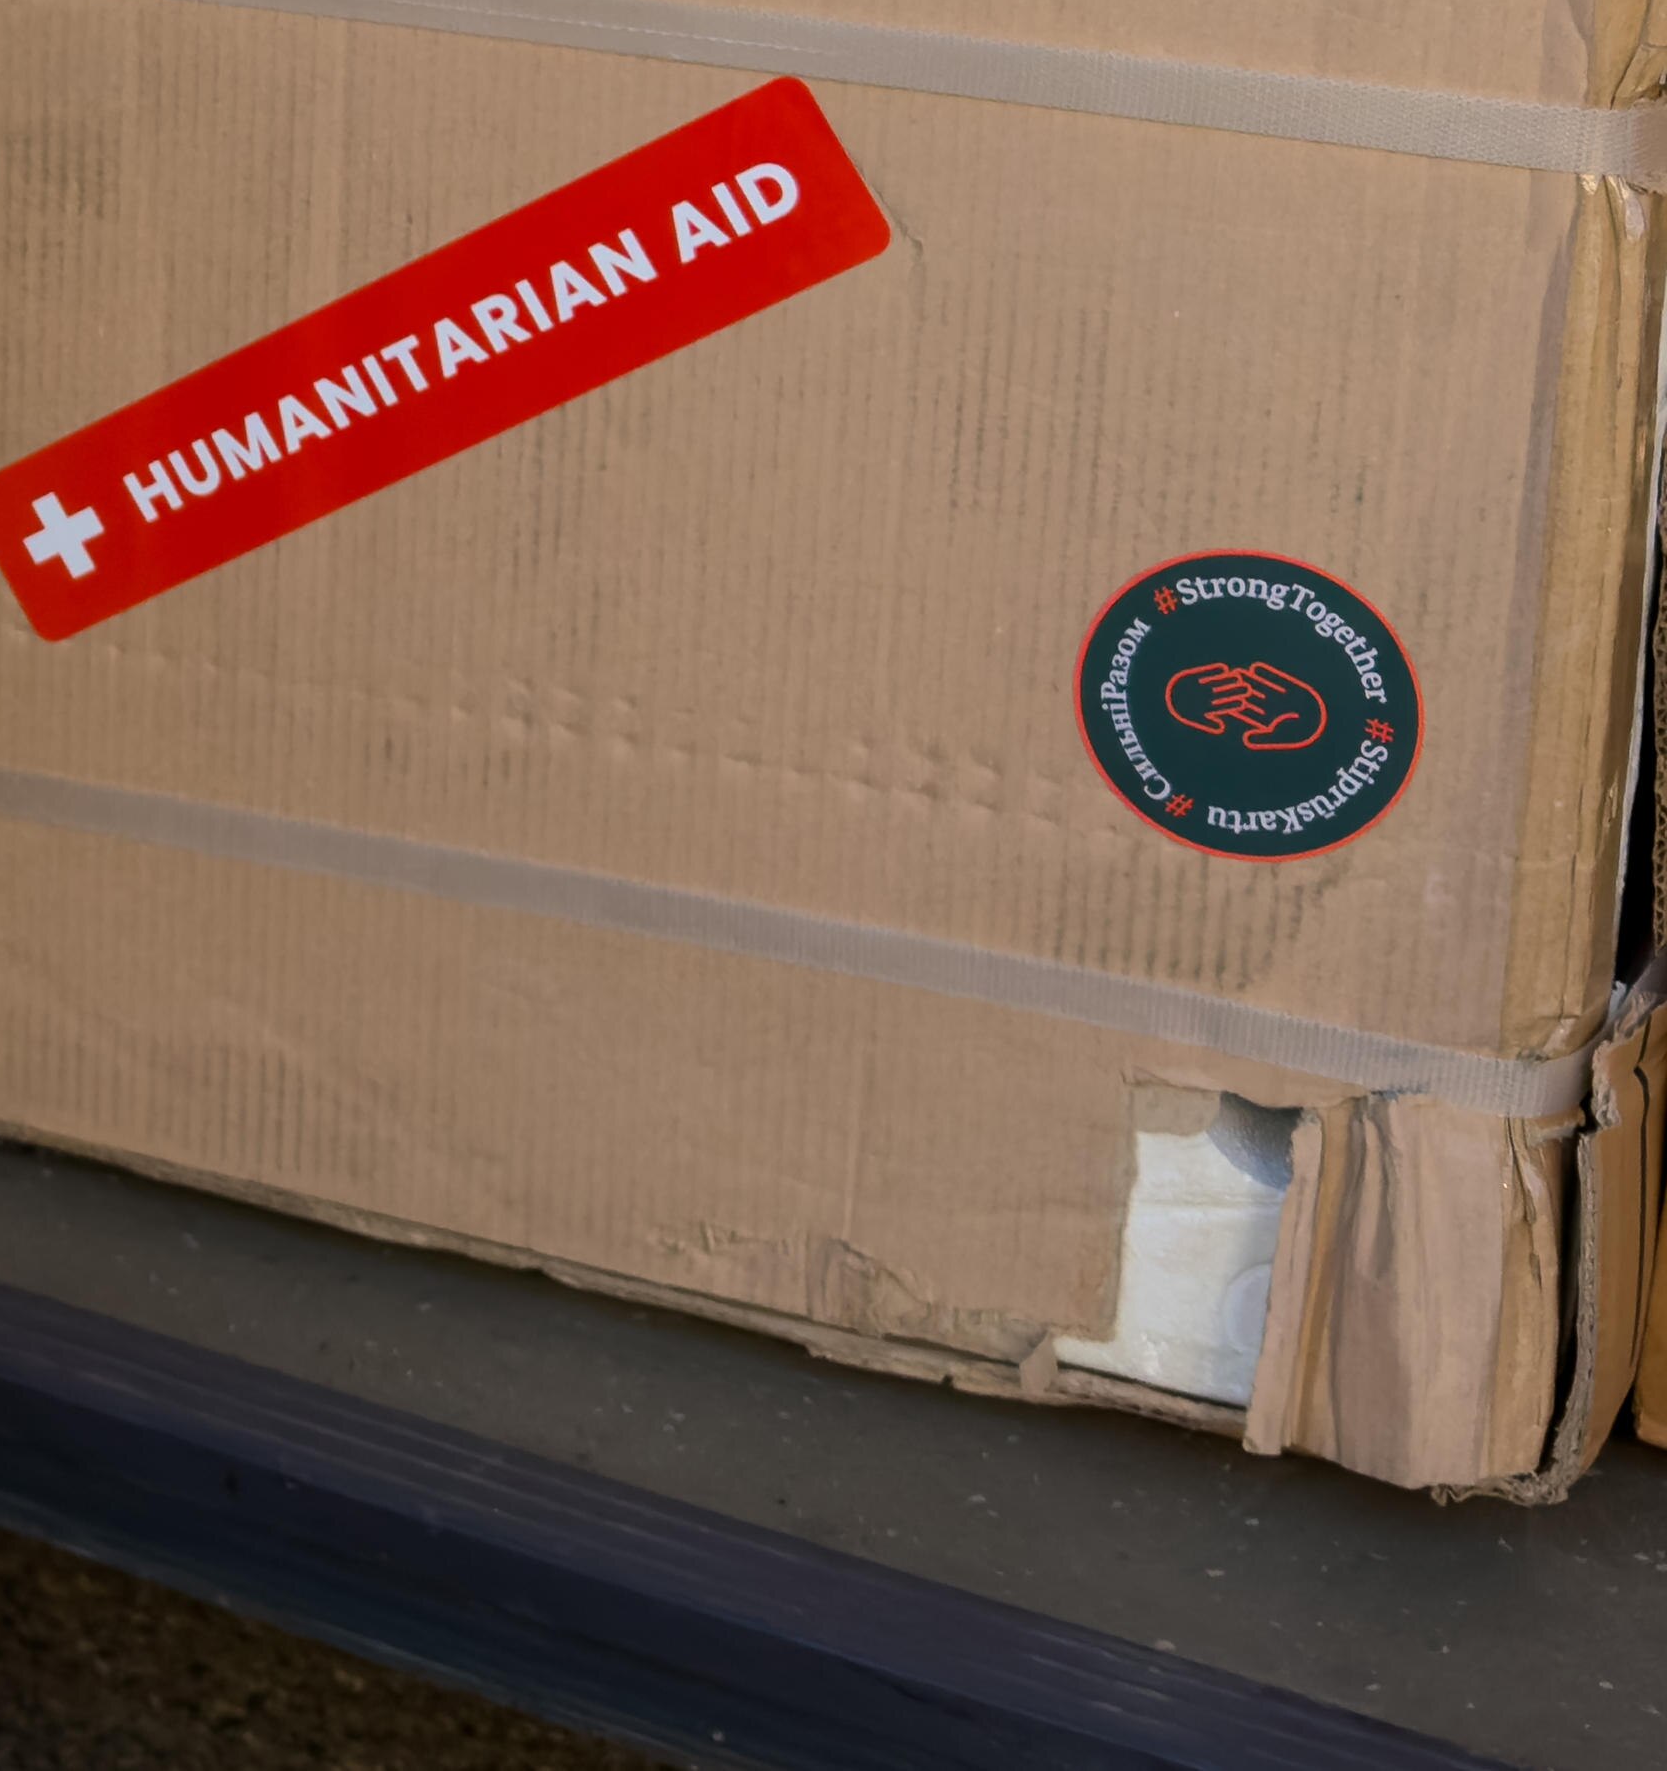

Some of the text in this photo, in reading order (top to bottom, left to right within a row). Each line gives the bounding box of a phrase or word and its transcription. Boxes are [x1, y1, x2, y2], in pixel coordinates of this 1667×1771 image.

[122, 161, 801, 523] HUMANITARIAN AID
[1153, 576, 1388, 705] #StrongTogether
[1206, 718, 1395, 835] #StiprūsKartu
